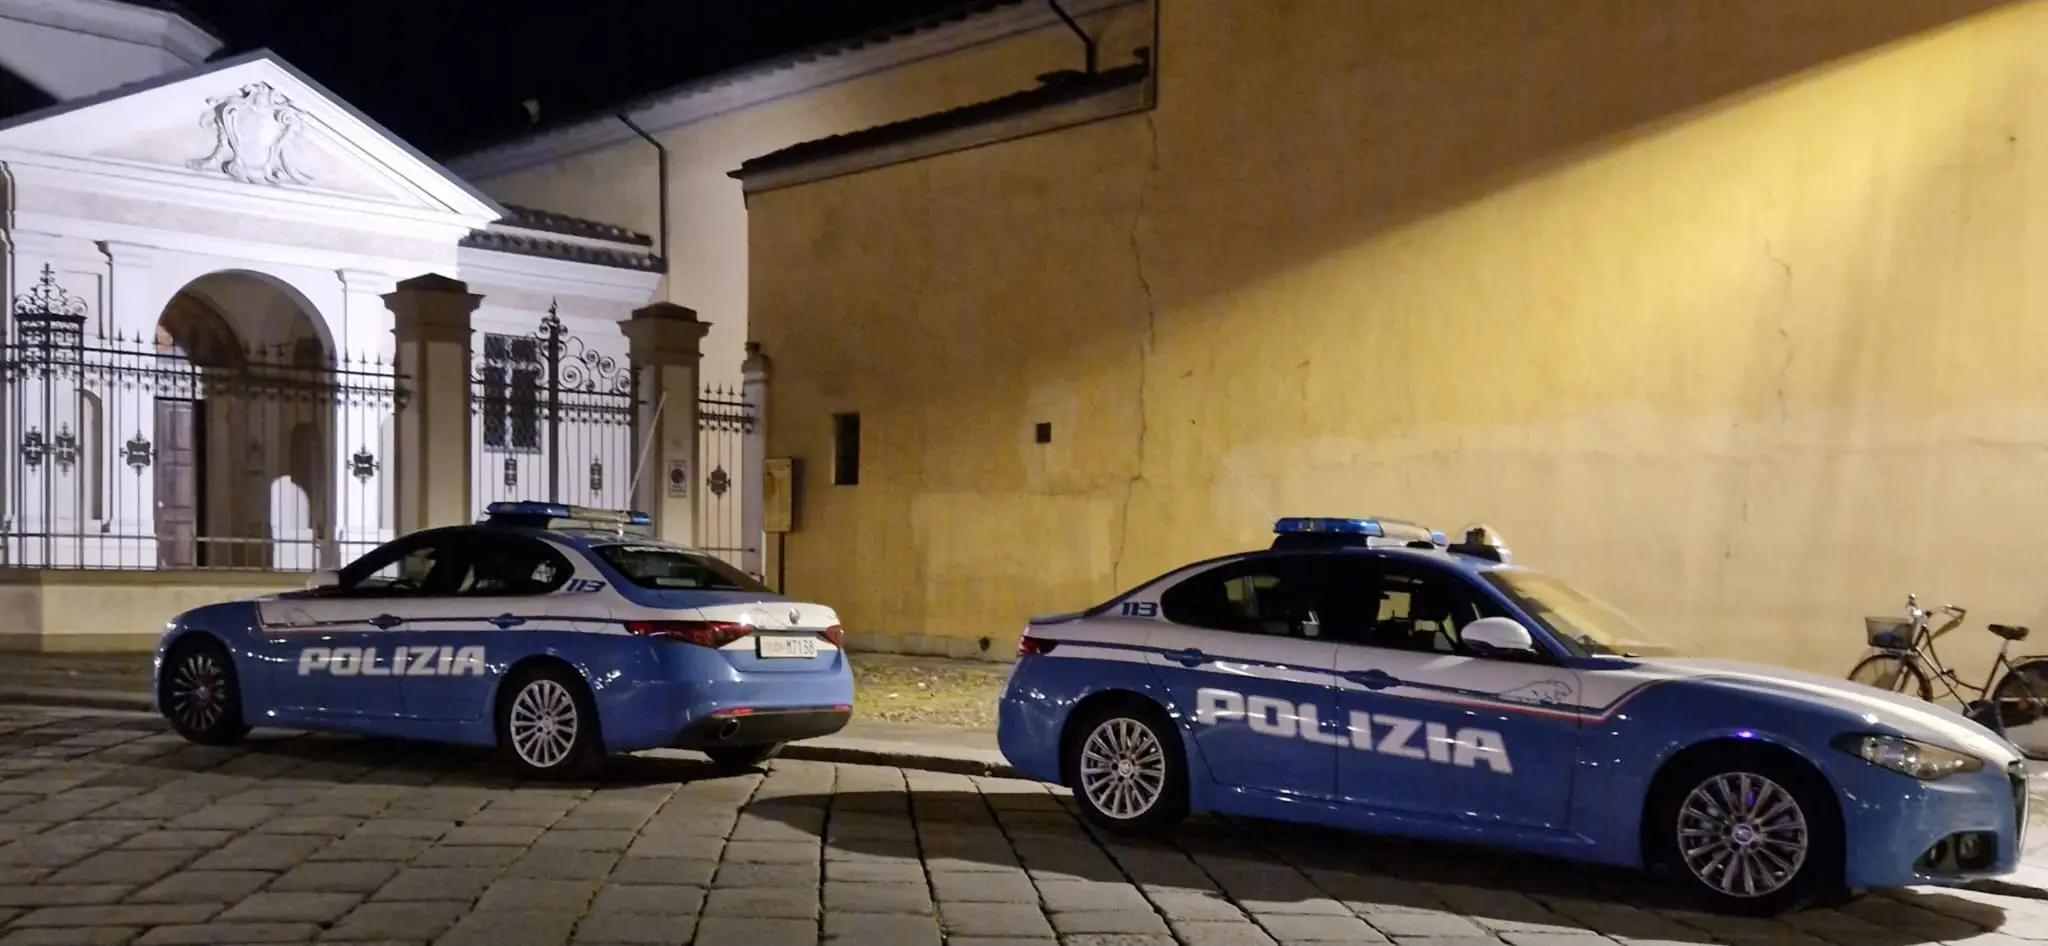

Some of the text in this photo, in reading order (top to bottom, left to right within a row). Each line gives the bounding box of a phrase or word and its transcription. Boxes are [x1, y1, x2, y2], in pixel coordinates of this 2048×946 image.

[566, 578, 606, 593] 113
[1122, 602, 1158, 617] 113
[298, 645, 485, 676] POLIZIA
[1196, 687, 1513, 774] POLIZIA
